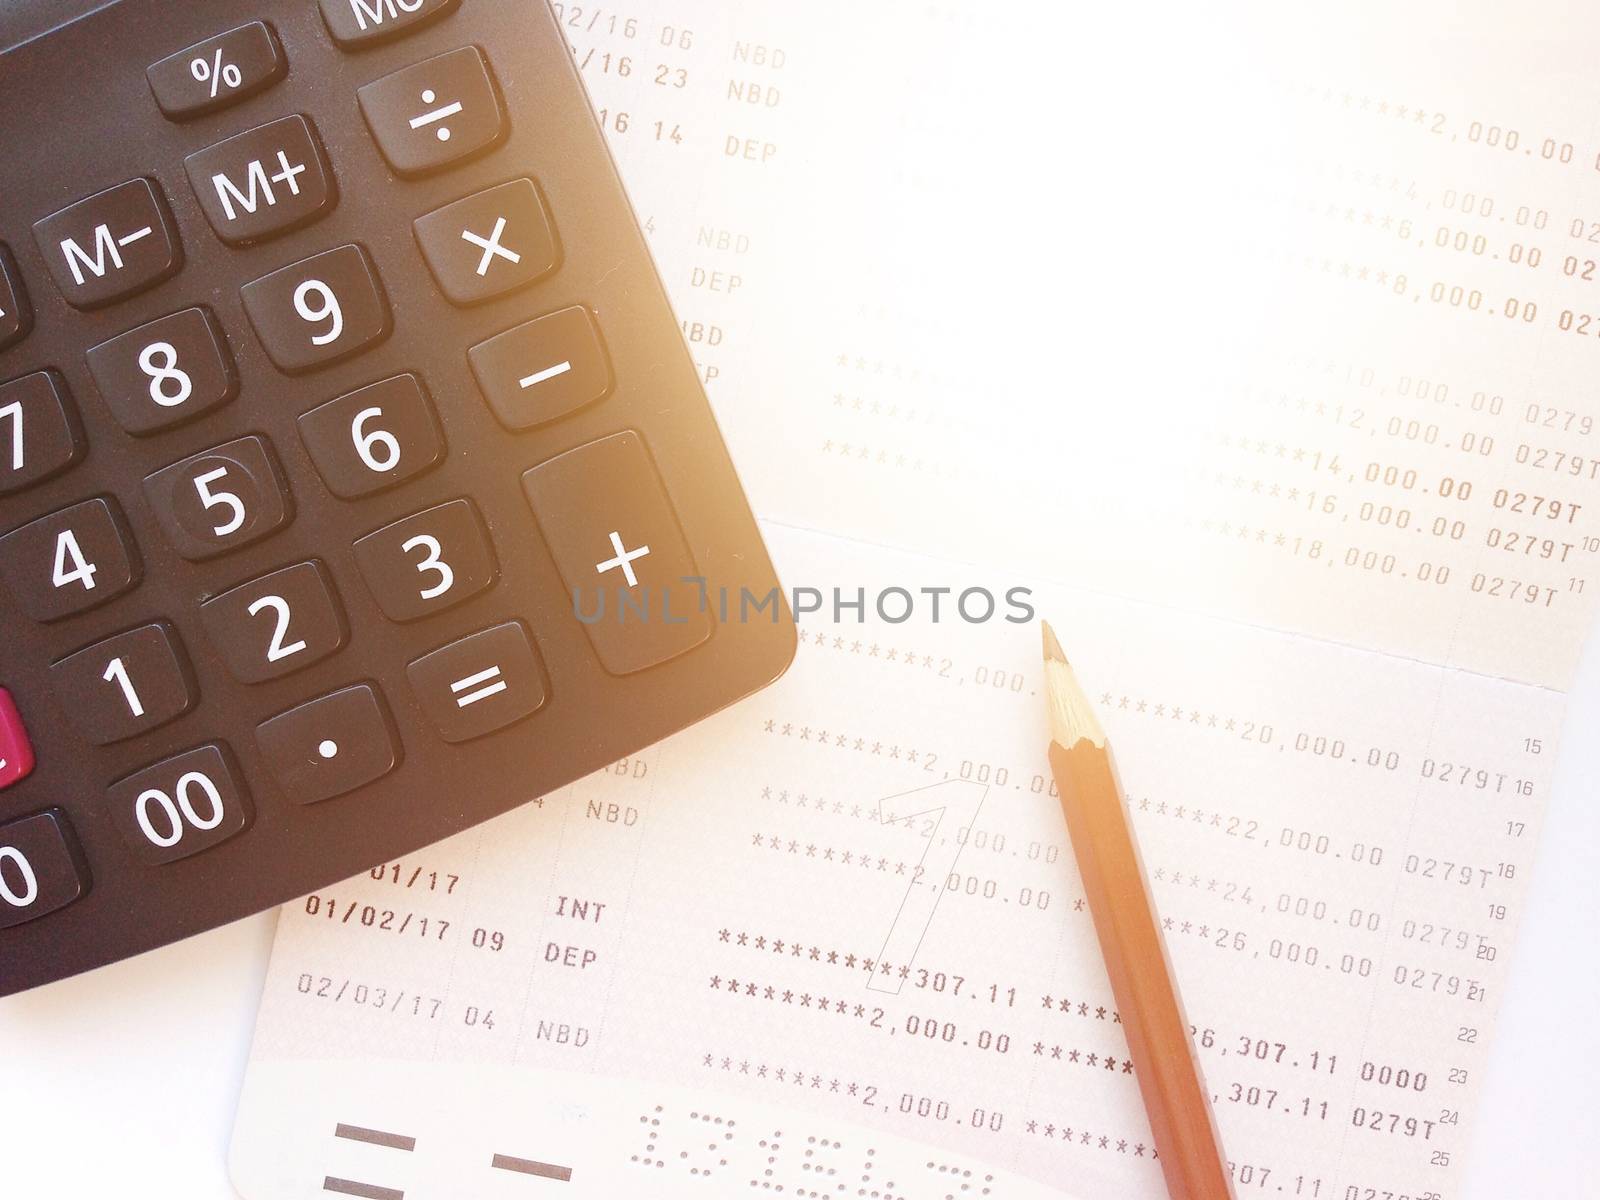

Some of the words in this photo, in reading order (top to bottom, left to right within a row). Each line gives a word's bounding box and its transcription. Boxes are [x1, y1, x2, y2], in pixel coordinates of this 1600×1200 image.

[660, 25, 693, 50] 06
[733, 41, 786, 69] NBD
[190, 48, 242, 98] %
[655, 64, 688, 89] 23
[727, 79, 780, 108] NBD
[654, 121, 682, 144] 14
[724, 135, 777, 163] DEP
[211, 151, 306, 220] M+
[697, 226, 750, 254] NBD
[691, 267, 742, 293] DEP
[293, 279, 344, 346] 9
[138, 341, 192, 407] 8
[351, 407, 401, 472] 6
[193, 466, 246, 536] 5
[1493, 489, 1582, 524] 0279T
[51, 529, 97, 591] 4
[401, 534, 454, 600] 3
[1486, 528, 1575, 563] 0279T
[1470, 573, 1559, 608] 0279T
[1568, 577, 1585, 594] 11
[247, 595, 307, 662] 2
[102, 657, 144, 717] 1
[1524, 737, 1542, 754] 15
[1421, 758, 1508, 793] 0279T
[1515, 779, 1534, 796] 16
[135, 771, 225, 848] 00
[1507, 820, 1525, 837] 17
[0, 846, 38, 907] 0
[1405, 855, 1493, 889] 0279T
[1498, 862, 1516, 879] 18
[586, 800, 638, 826] NBD
[1467, 985, 1485, 1002] 21
[1488, 904, 1506, 920] 19
[1477, 944, 1496, 961] 20
[297, 973, 442, 1019] 02/03/17
[464, 1006, 496, 1030] 04
[536, 1020, 590, 1048] NBD
[304, 895, 451, 941] 01/02/17
[471, 928, 505, 952] 09
[544, 942, 597, 970] DEP
[1352, 1107, 1437, 1140] 0279T
[1440, 1109, 1459, 1126] 24
[555, 896, 607, 923] INT
[1361, 1061, 1427, 1092] 0000
[1448, 1068, 1468, 1085] 23
[1457, 1027, 1478, 1043] 22
[1431, 1150, 1449, 1167] 25
